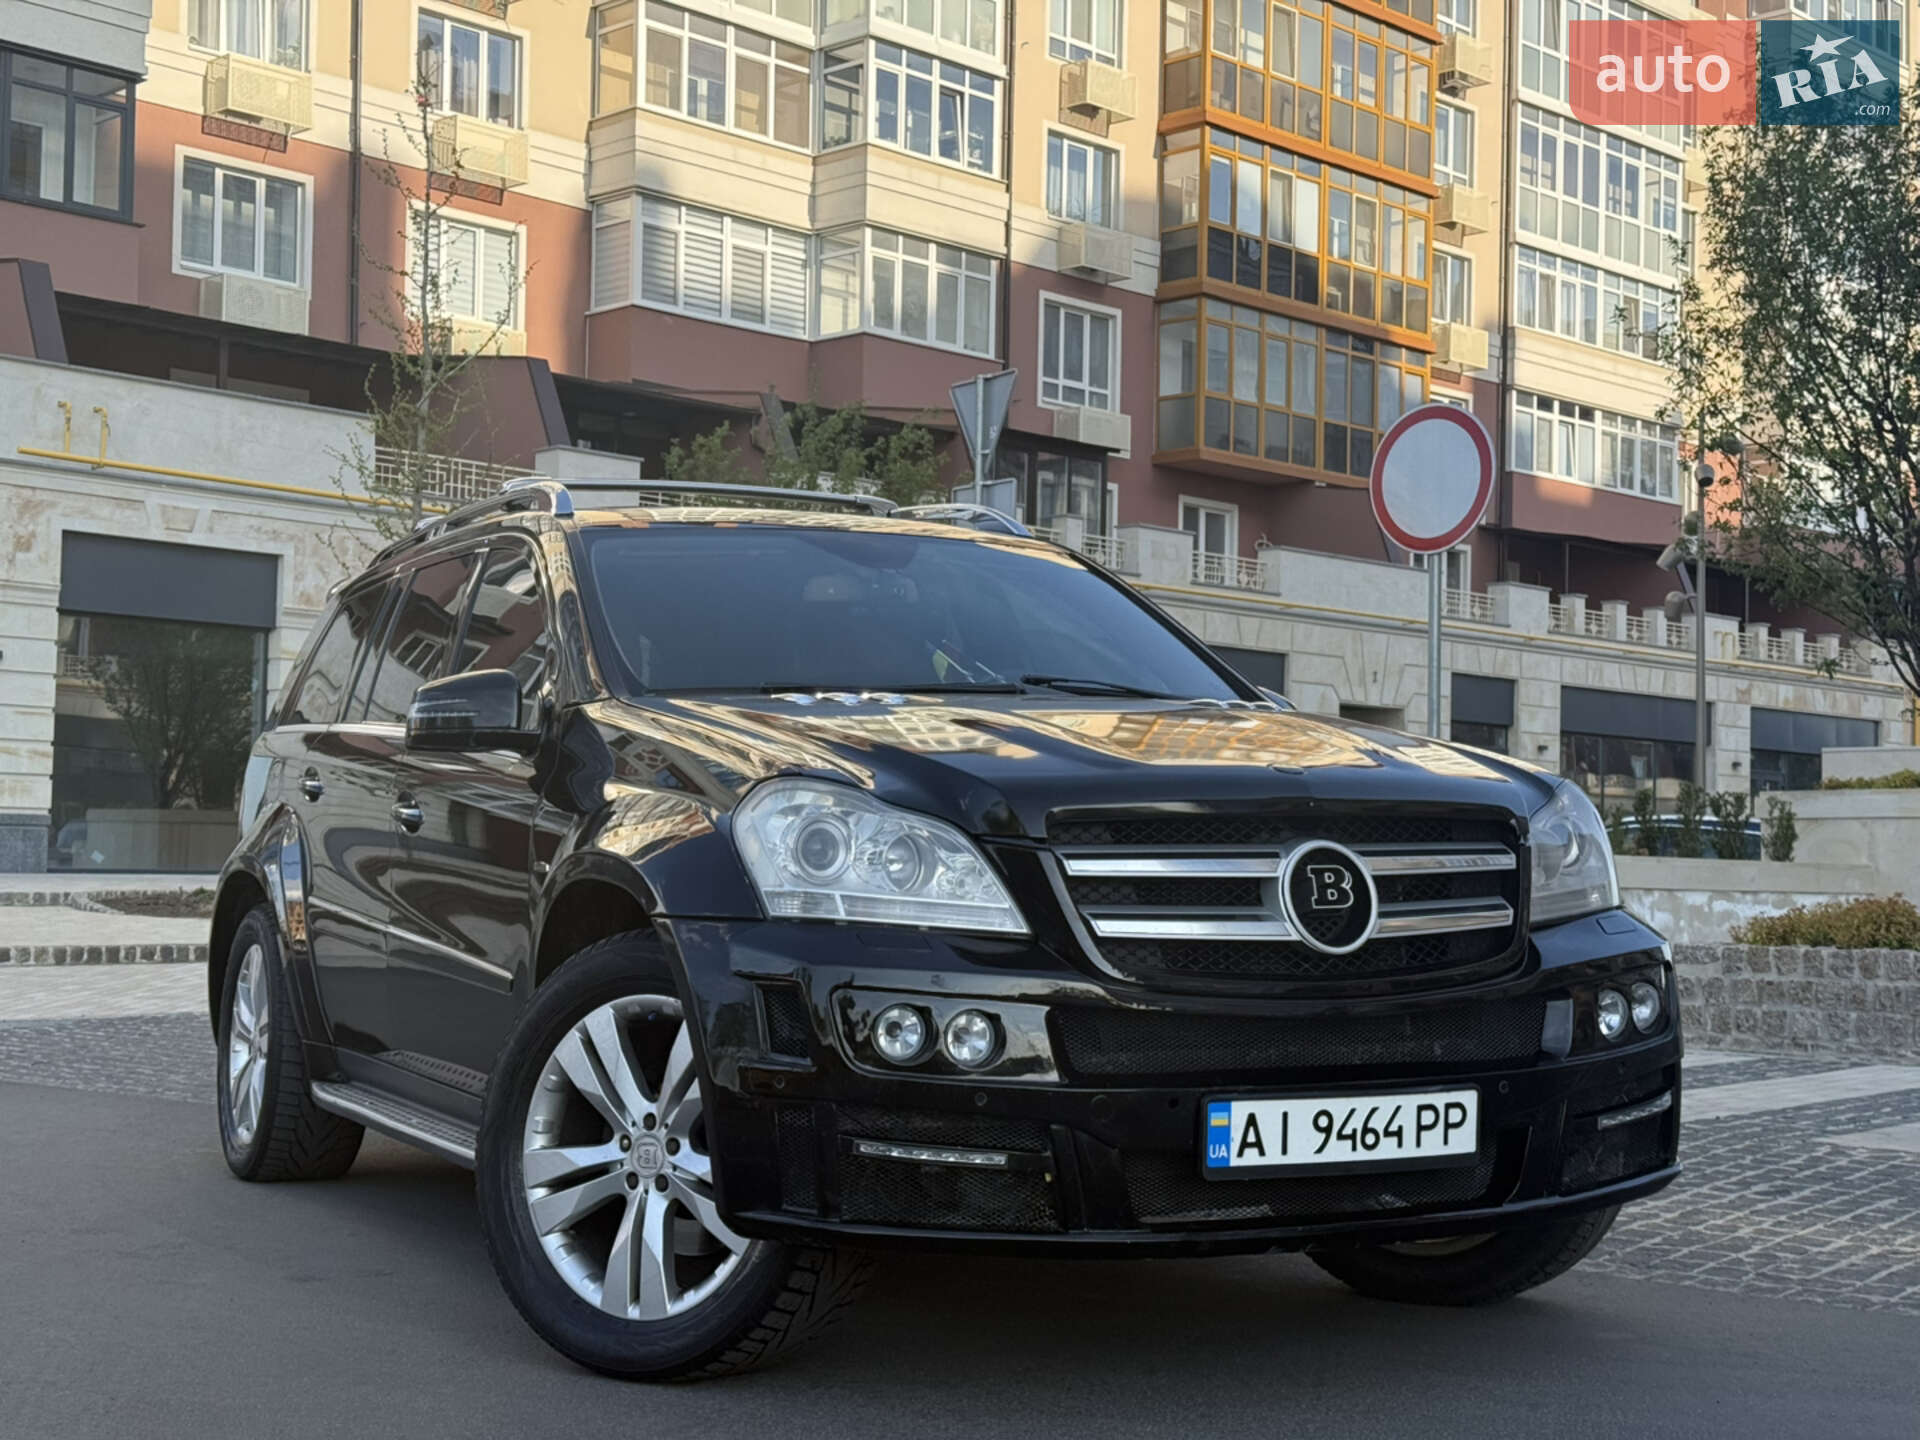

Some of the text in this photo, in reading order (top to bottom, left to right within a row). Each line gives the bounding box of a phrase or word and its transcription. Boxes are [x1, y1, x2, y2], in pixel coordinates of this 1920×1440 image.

[1307, 865, 1354, 909] B
[1209, 1144, 1228, 1159] UA
[1236, 1101, 1468, 1158] AI 9464 PP
